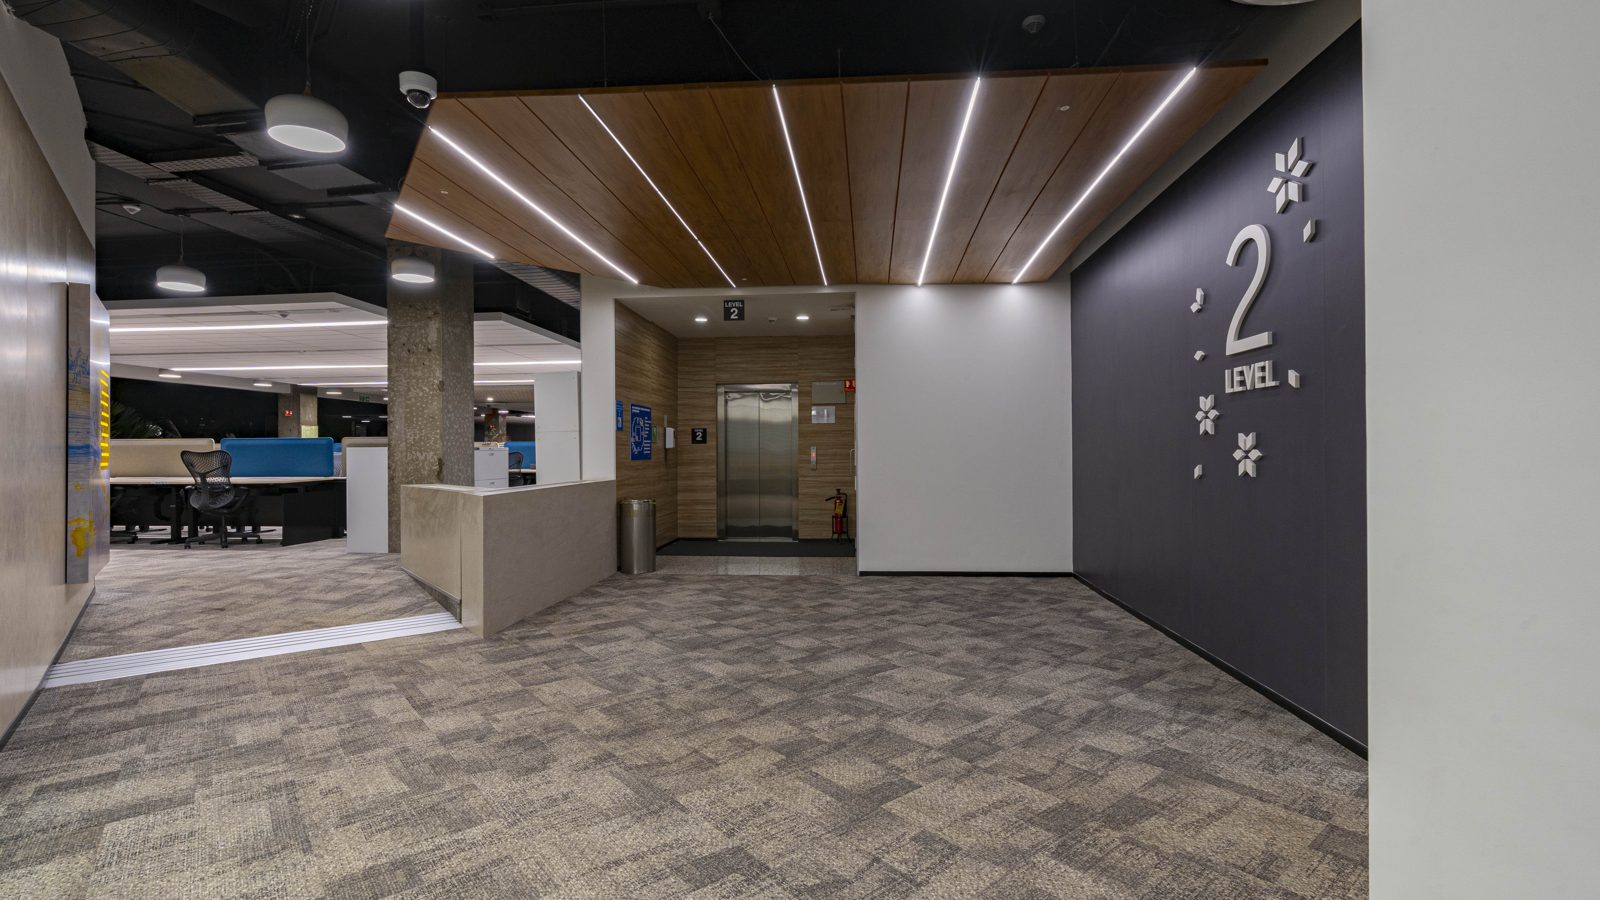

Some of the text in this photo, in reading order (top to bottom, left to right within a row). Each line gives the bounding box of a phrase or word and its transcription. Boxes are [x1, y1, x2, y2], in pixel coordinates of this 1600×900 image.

[1226, 224, 1272, 355] 2
[730, 307, 739, 319] 2
[1225, 360, 1280, 393] LEVEL
[696, 431, 703, 441] 2
